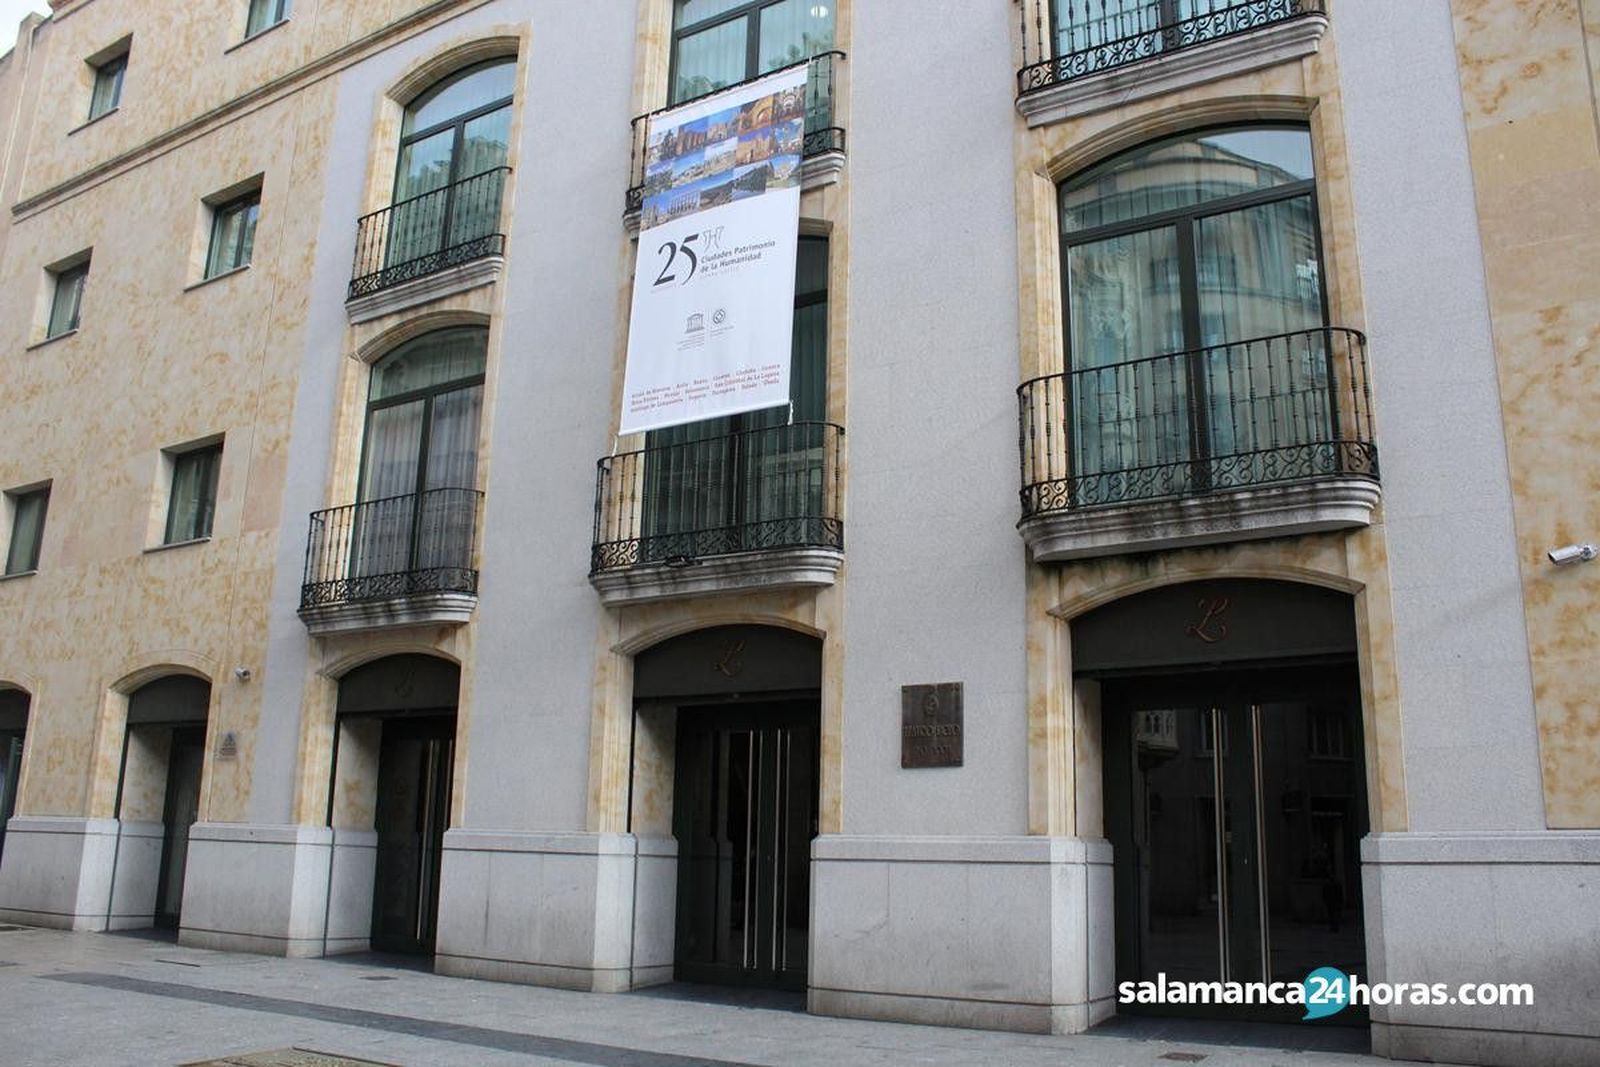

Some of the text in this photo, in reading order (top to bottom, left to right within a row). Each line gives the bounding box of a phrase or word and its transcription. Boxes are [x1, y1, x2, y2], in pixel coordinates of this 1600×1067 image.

[653, 233, 699, 286] 25
[701, 240, 776, 264] Ciudades Patrimonio
[719, 252, 762, 268] Humanidad
